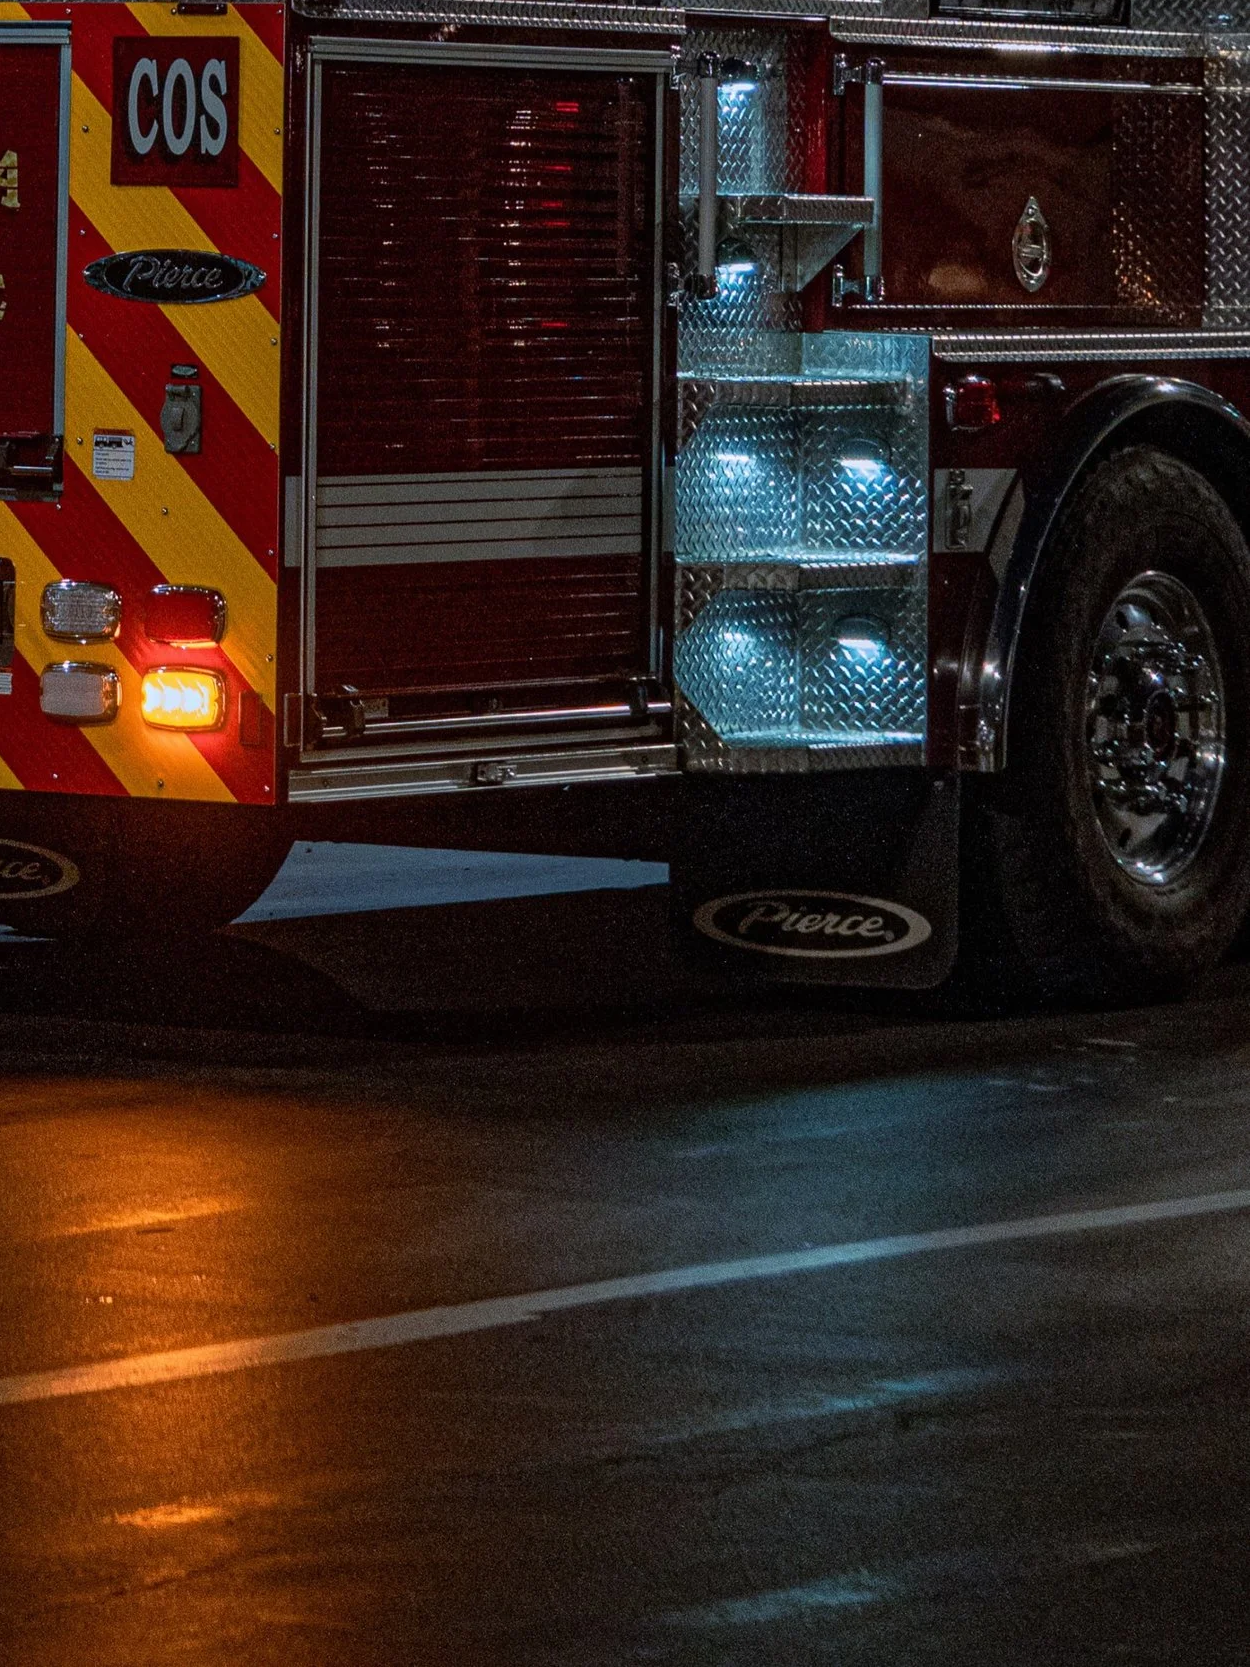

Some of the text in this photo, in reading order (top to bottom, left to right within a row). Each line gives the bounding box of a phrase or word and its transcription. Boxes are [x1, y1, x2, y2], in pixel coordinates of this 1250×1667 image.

[128, 57, 228, 157] COS
[121, 254, 225, 294] Pierce
[737, 900, 886, 937] Pierce
